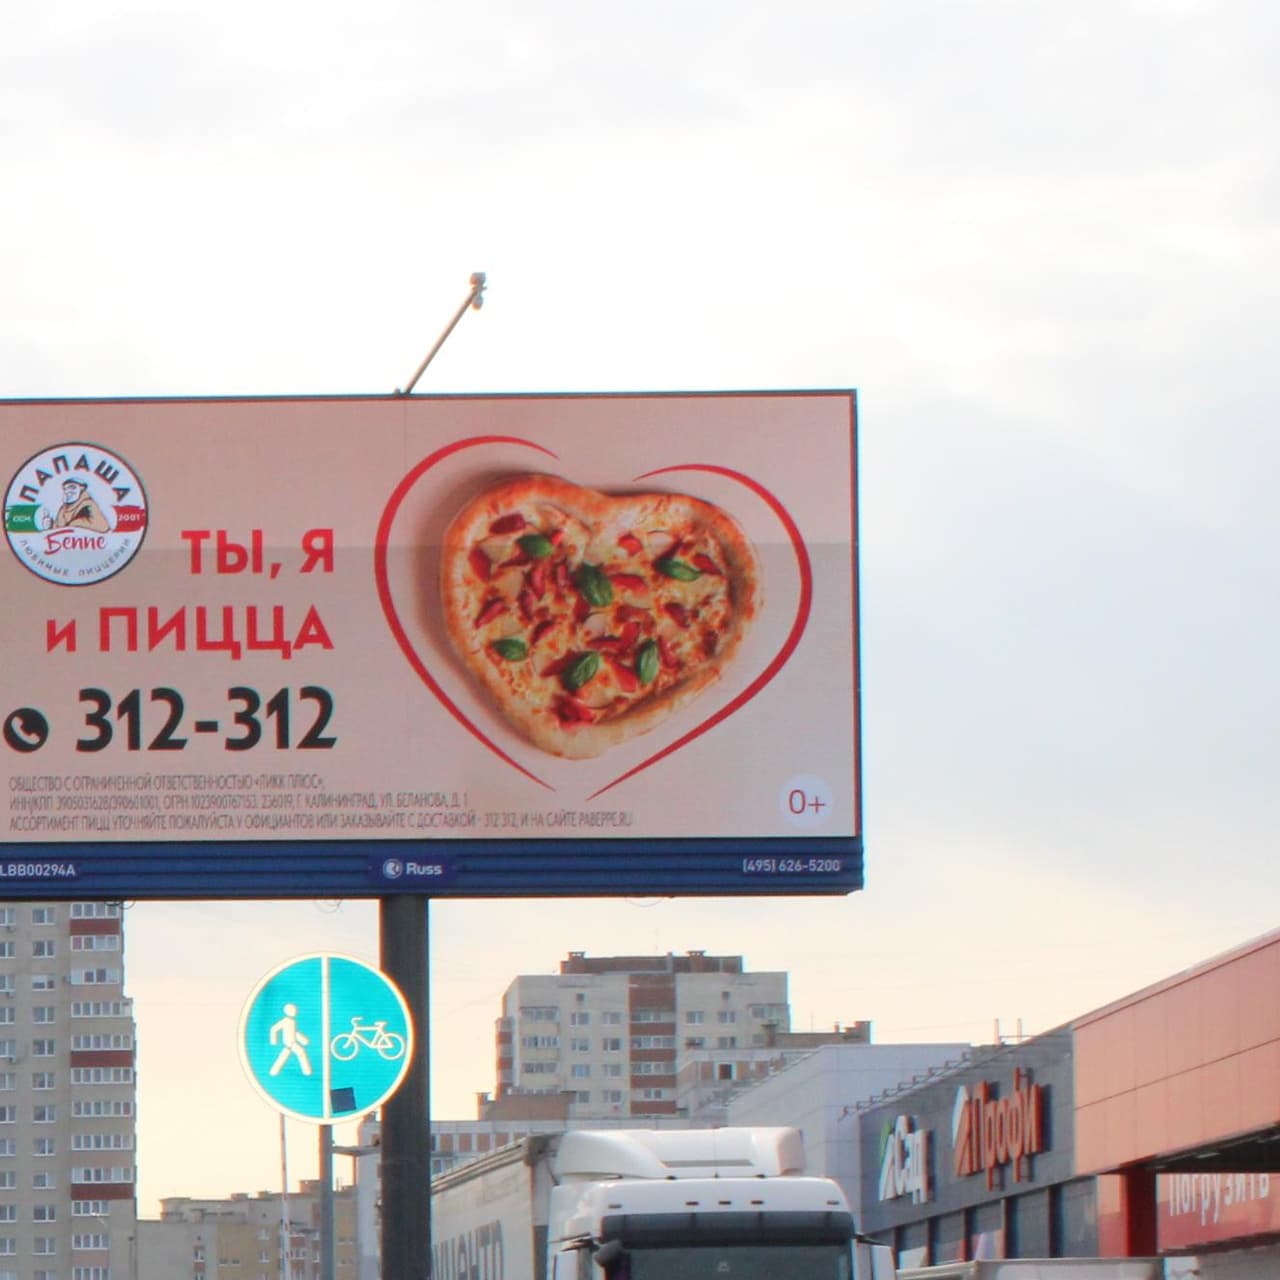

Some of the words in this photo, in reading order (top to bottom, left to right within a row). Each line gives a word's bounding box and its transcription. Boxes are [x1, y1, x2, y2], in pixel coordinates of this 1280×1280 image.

[19, 454, 131, 503] ПАПАША
[44, 529, 106, 555] Беппе
[181, 528, 282, 580] ТЫ,
[299, 528, 334, 573] Я
[99, 603, 335, 660] ПИЦЦА
[75, 685, 338, 752] 312-312
[8, 775, 62, 793] ОБЩЕСТВО
[64, 775, 72, 791] С
[73, 772, 151, 791] ОГРАНИЧЕННОЙ
[153, 774, 253, 791] ОТВЕТСТВЕННОСТЬЮ
[788, 789, 826, 814] 0+
[9, 815, 79, 831] АССОРТИМЕНТ
[168, 811, 233, 830] ПОЖАЛУЙСТА
[406, 862, 442, 875] Russ
[778, 859, 840, 872] 626-5200
[966, 1066, 1044, 1192] Профи
[894, 1114, 930, 1205] Сад
